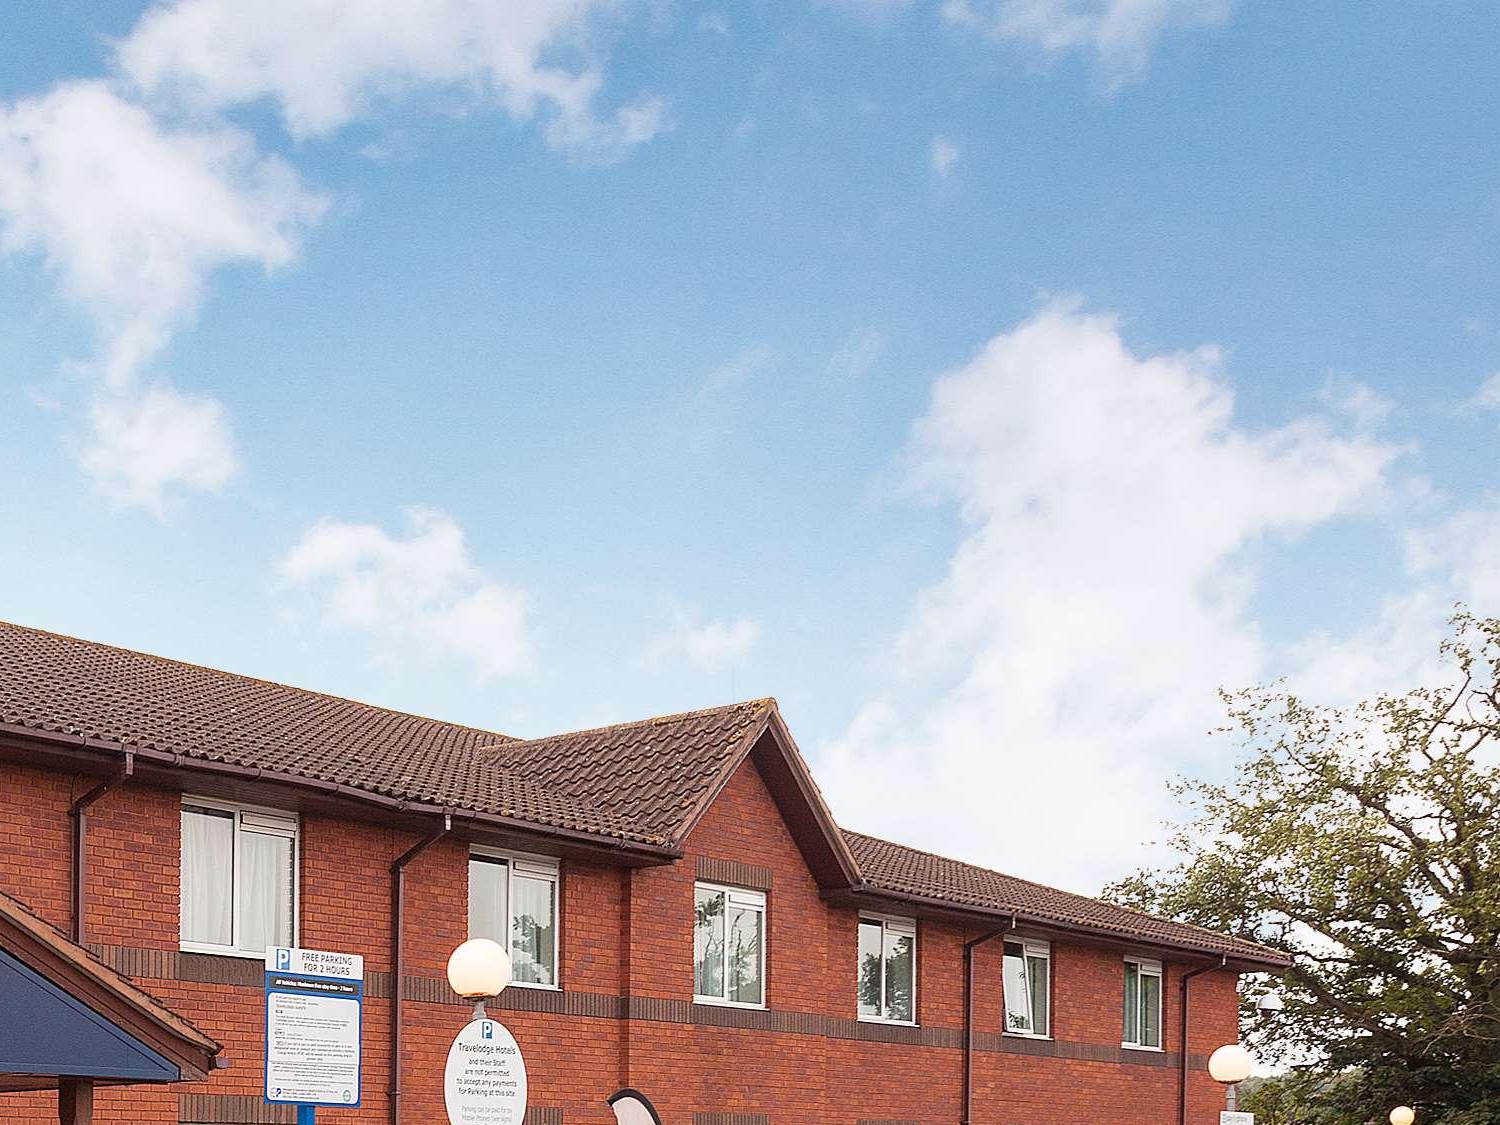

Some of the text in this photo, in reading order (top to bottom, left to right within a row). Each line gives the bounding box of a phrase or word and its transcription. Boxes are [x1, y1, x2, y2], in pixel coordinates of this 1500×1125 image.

[302, 953, 352, 965] FREE PARKING
[304, 963, 350, 975] FOR 2 HOURS
[458, 1043, 515, 1055] Travelodge Hotels
[468, 1088, 487, 1097] Parking
